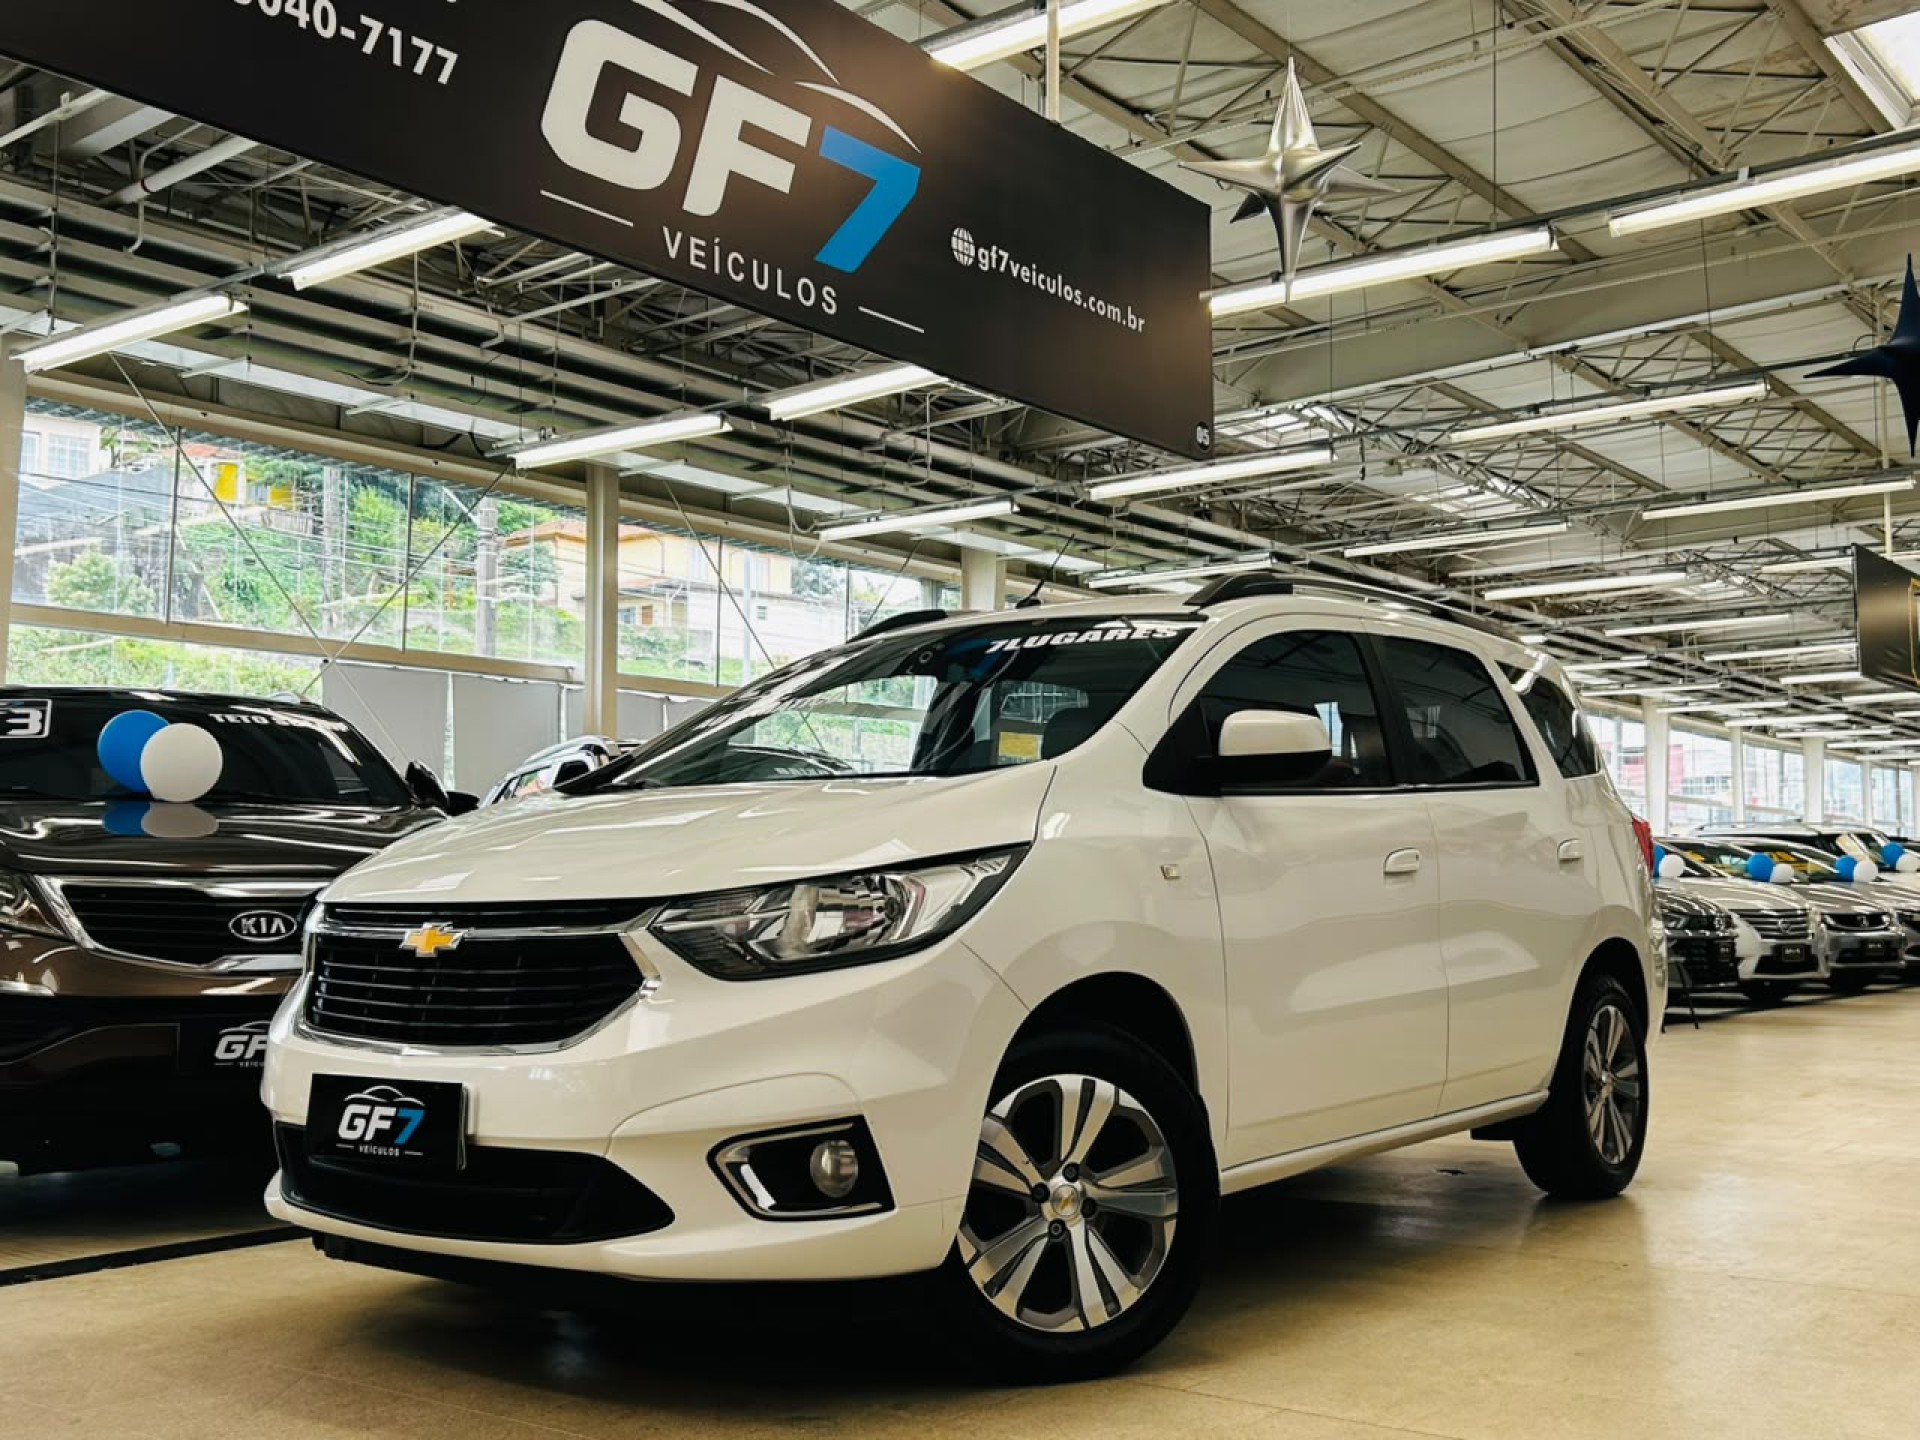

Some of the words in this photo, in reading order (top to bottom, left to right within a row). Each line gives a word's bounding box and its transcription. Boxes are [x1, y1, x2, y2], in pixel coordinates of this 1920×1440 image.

[541, 18, 922, 274] GF7
[662, 225, 838, 315] VEÍCULOS
[977, 245, 1146, 333] gf7veiculos.com.br
[241, 917, 286, 934] KIA
[338, 1104, 425, 1146] GF7
